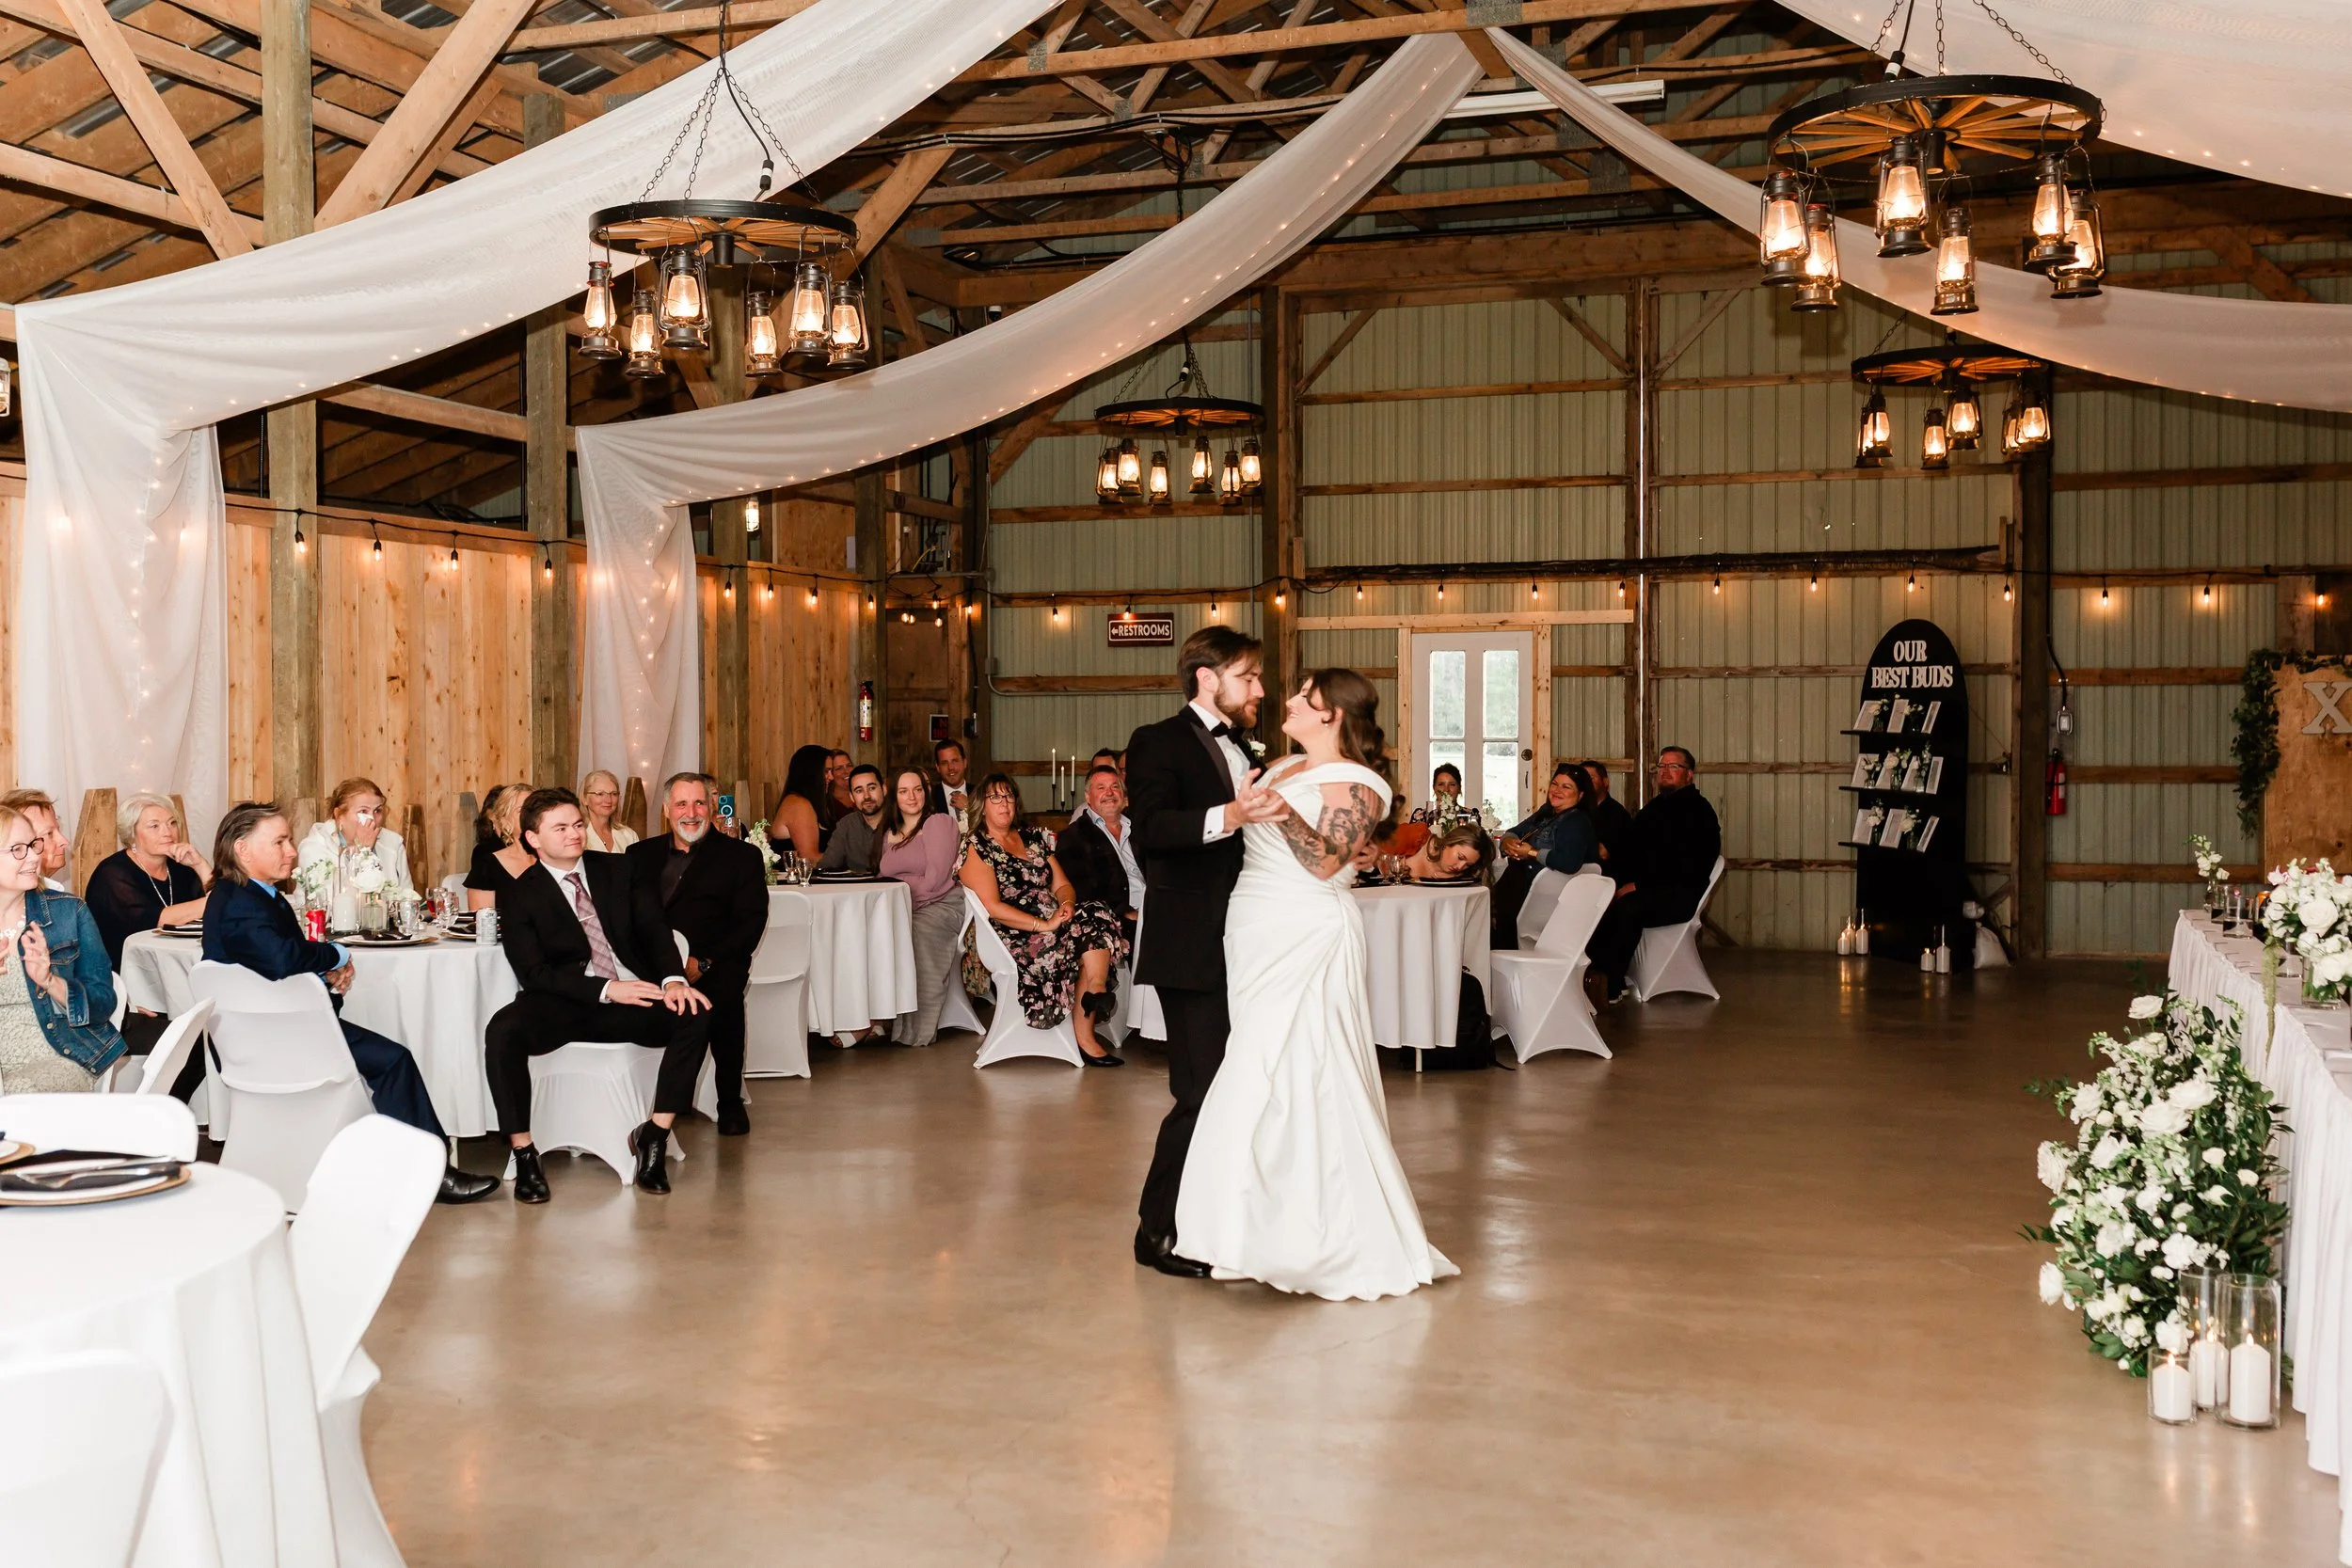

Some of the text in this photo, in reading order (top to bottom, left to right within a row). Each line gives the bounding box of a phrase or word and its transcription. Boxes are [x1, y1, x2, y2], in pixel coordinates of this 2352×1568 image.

[1119, 624, 1169, 636] RESTROOMS
[1893, 640, 1928, 662] OUR
[1871, 665, 1954, 689] BEST BUDS
[2301, 682, 2352, 734] X
